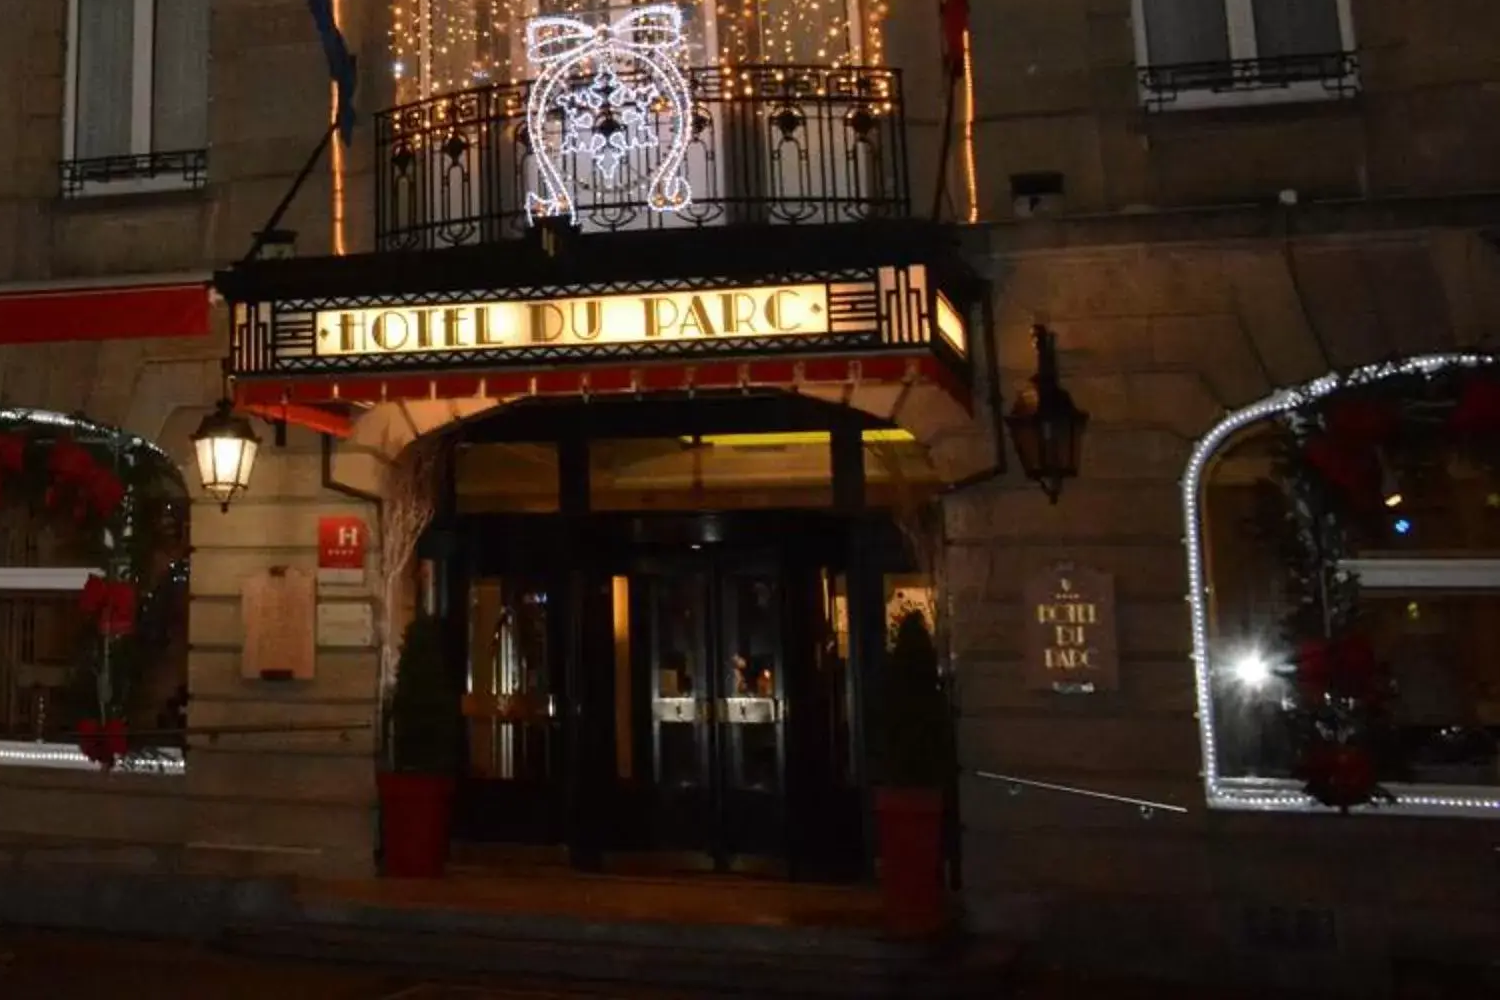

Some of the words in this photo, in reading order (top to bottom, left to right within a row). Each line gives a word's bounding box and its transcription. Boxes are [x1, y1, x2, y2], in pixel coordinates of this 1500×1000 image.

[337, 306, 504, 351] HOTEL
[527, 300, 602, 343] DU
[638, 289, 802, 338] PARC
[339, 526, 358, 547] H
[1036, 604, 1099, 623] HOTEL
[1056, 625, 1084, 645] DU
[1045, 649, 1099, 668] PARC
